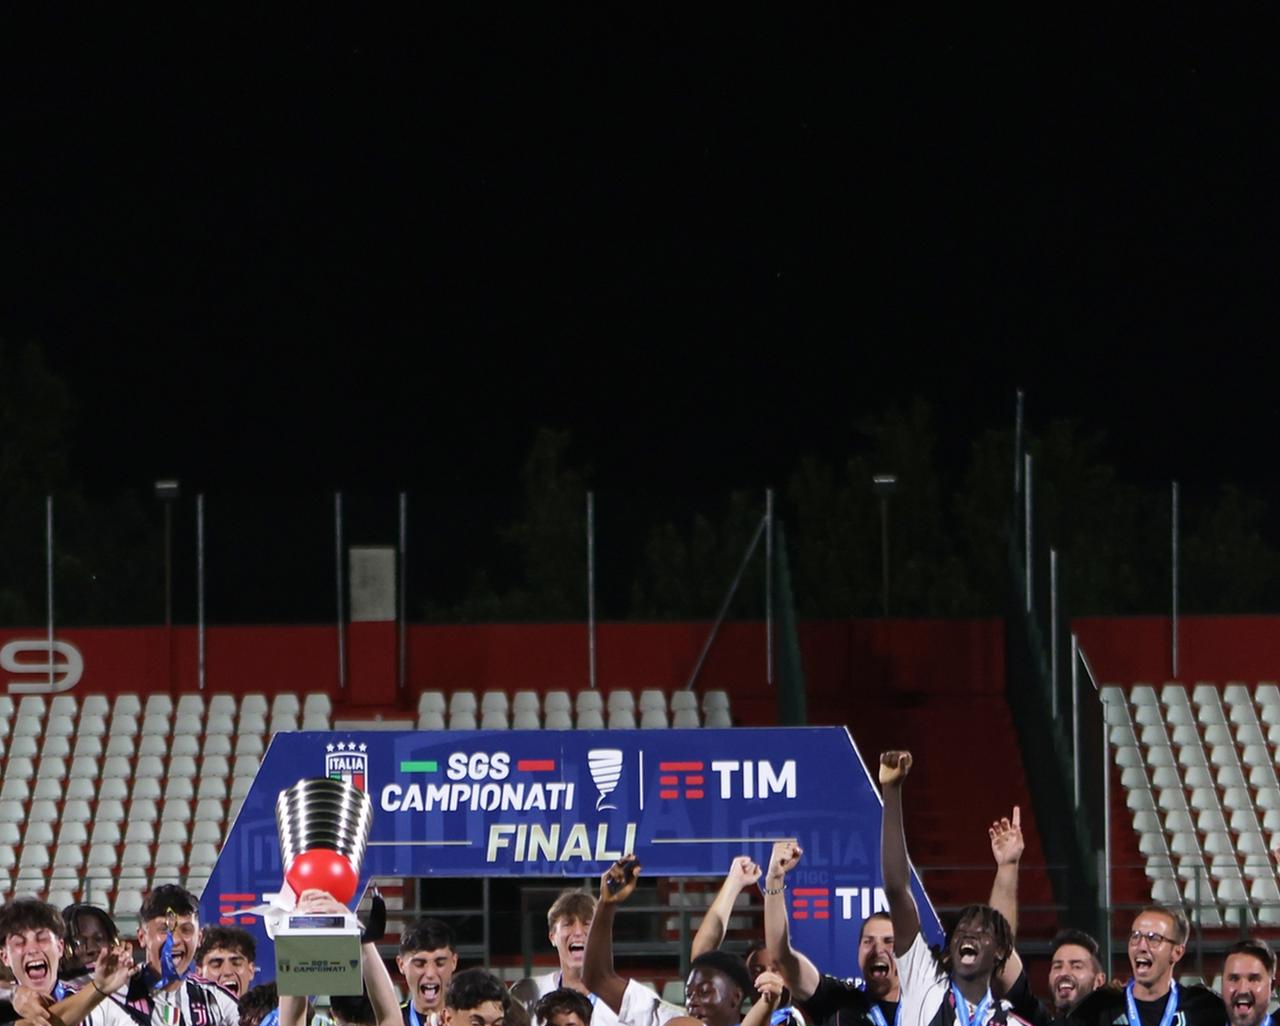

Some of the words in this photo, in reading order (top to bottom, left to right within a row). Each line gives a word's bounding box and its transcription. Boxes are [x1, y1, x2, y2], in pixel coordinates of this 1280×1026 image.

[329, 756, 364, 770] ITALIA
[446, 752, 511, 781] SGS
[711, 760, 797, 799] TIM
[380, 782, 575, 812] CAMPIONATI
[486, 823, 637, 862] FINALI
